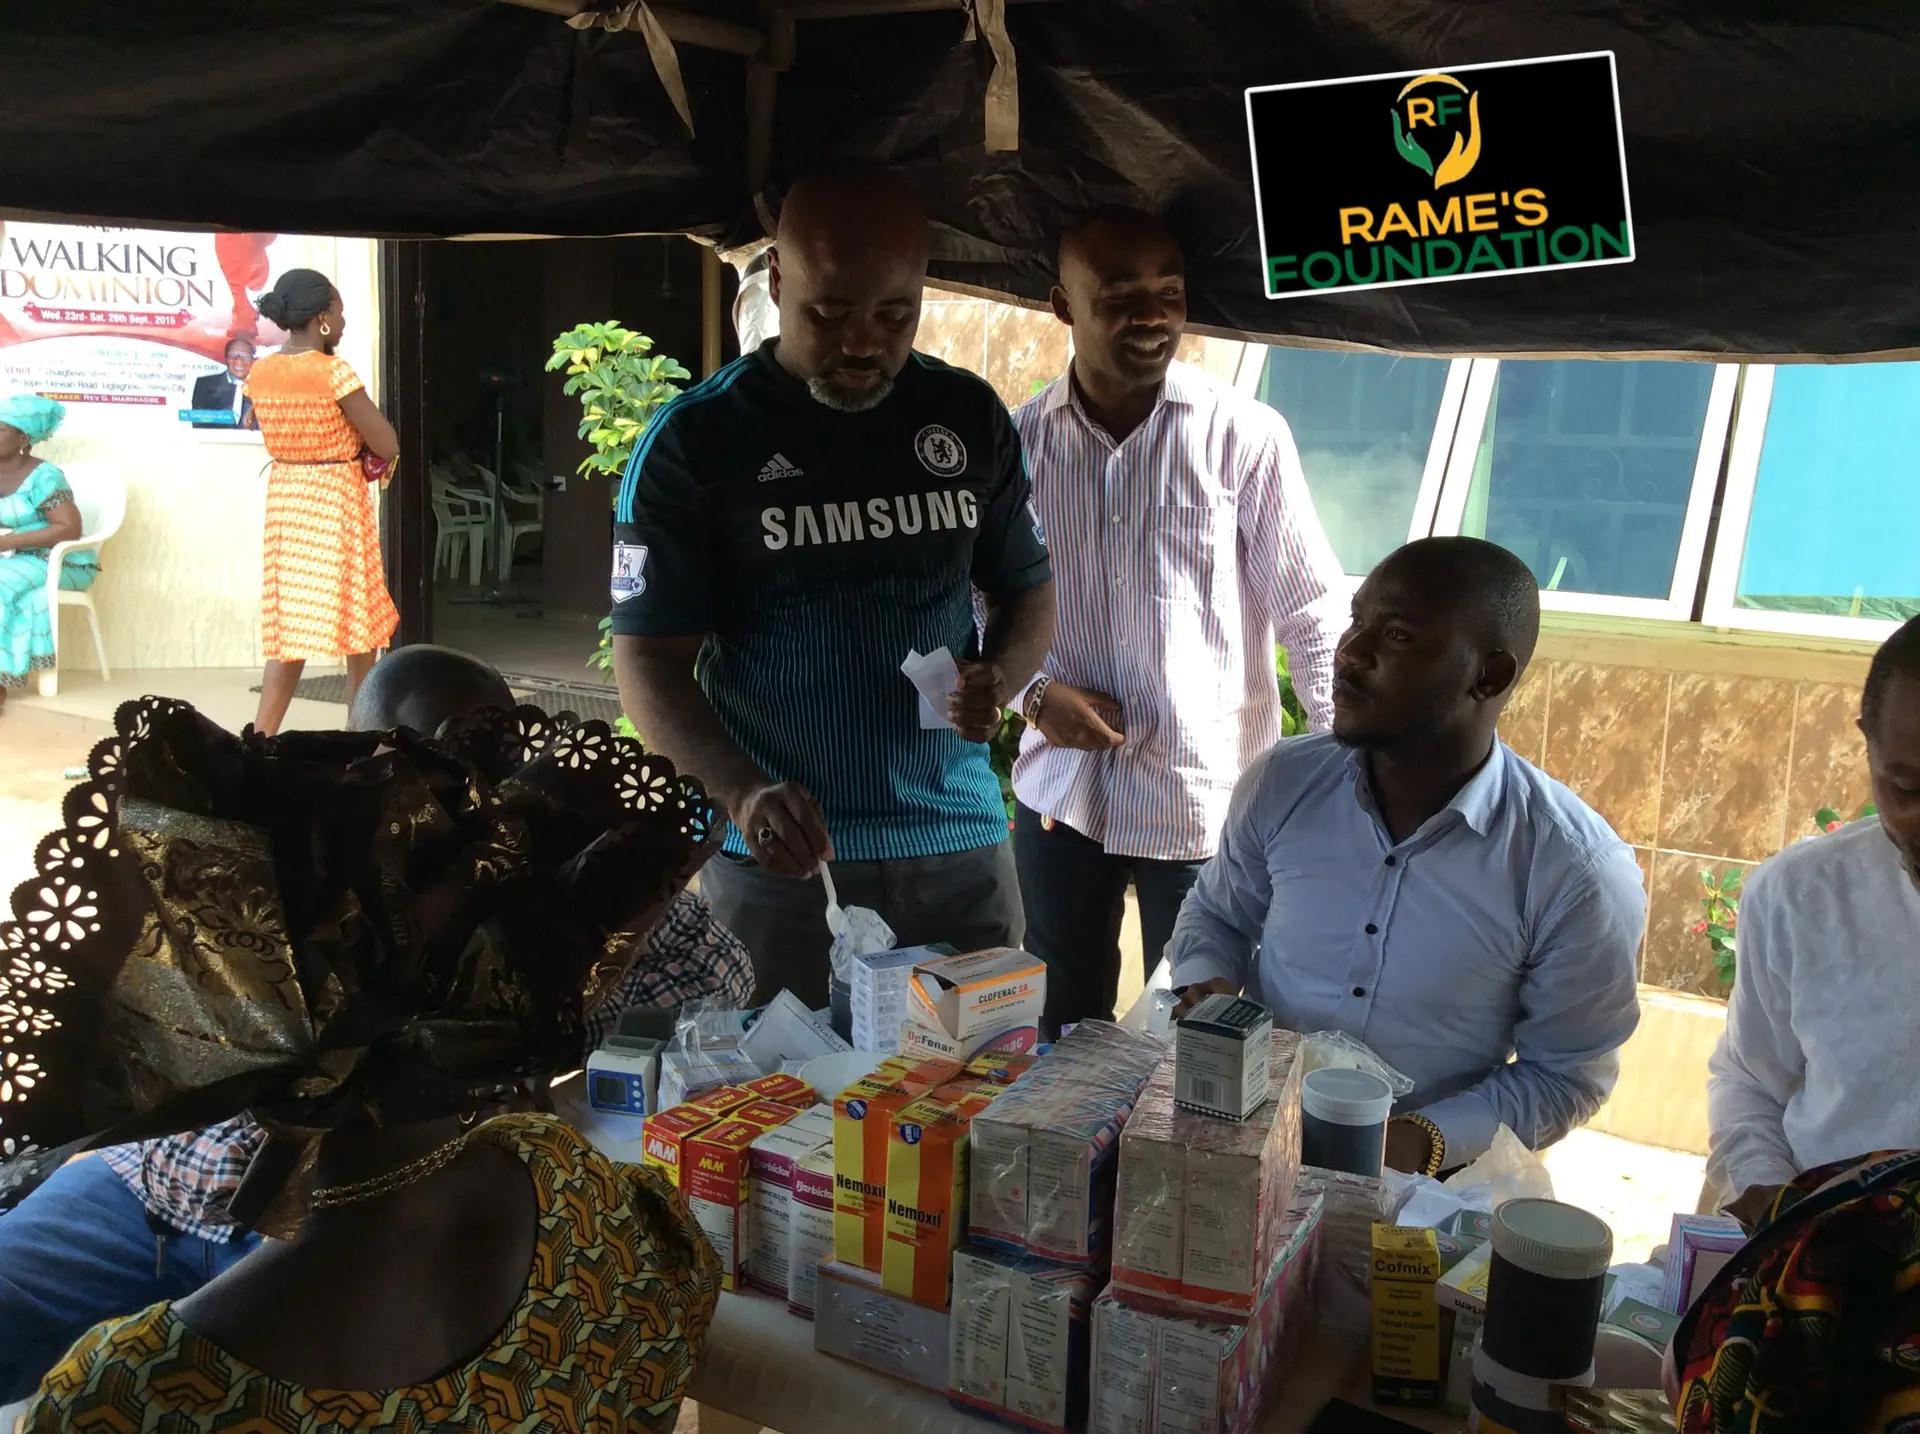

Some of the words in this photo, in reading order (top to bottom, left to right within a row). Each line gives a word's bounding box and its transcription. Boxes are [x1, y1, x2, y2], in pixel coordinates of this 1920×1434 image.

[9, 237, 198, 277] WALKING
[0, 268, 214, 308] DOMINION
[757, 468, 804, 482] adidas
[761, 489, 978, 550] SAMSUNG
[978, 986, 1017, 1004] CLOFENAC
[836, 1173, 886, 1200] Nemoxil
[888, 1199, 942, 1227] Nemoxil
[1375, 1259, 1431, 1275] Cofmix
